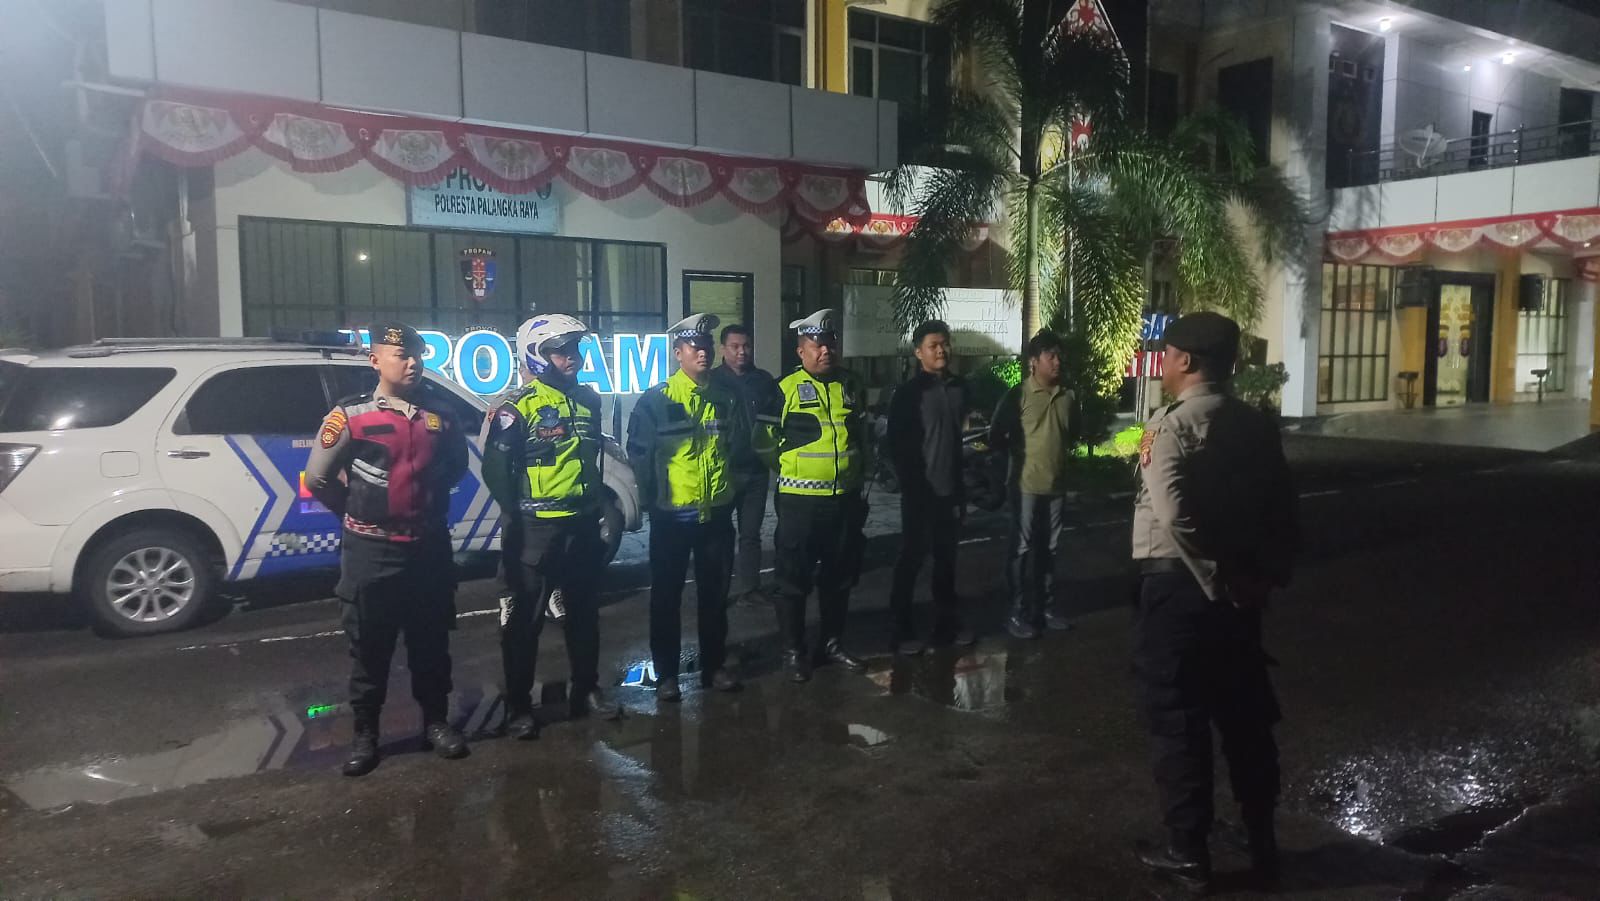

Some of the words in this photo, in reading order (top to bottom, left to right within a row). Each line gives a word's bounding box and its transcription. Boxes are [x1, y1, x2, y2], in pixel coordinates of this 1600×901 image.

[435, 193, 476, 215] POLRESTA
[477, 196, 519, 219] PALANGKA
[519, 201, 539, 220] RAYA
